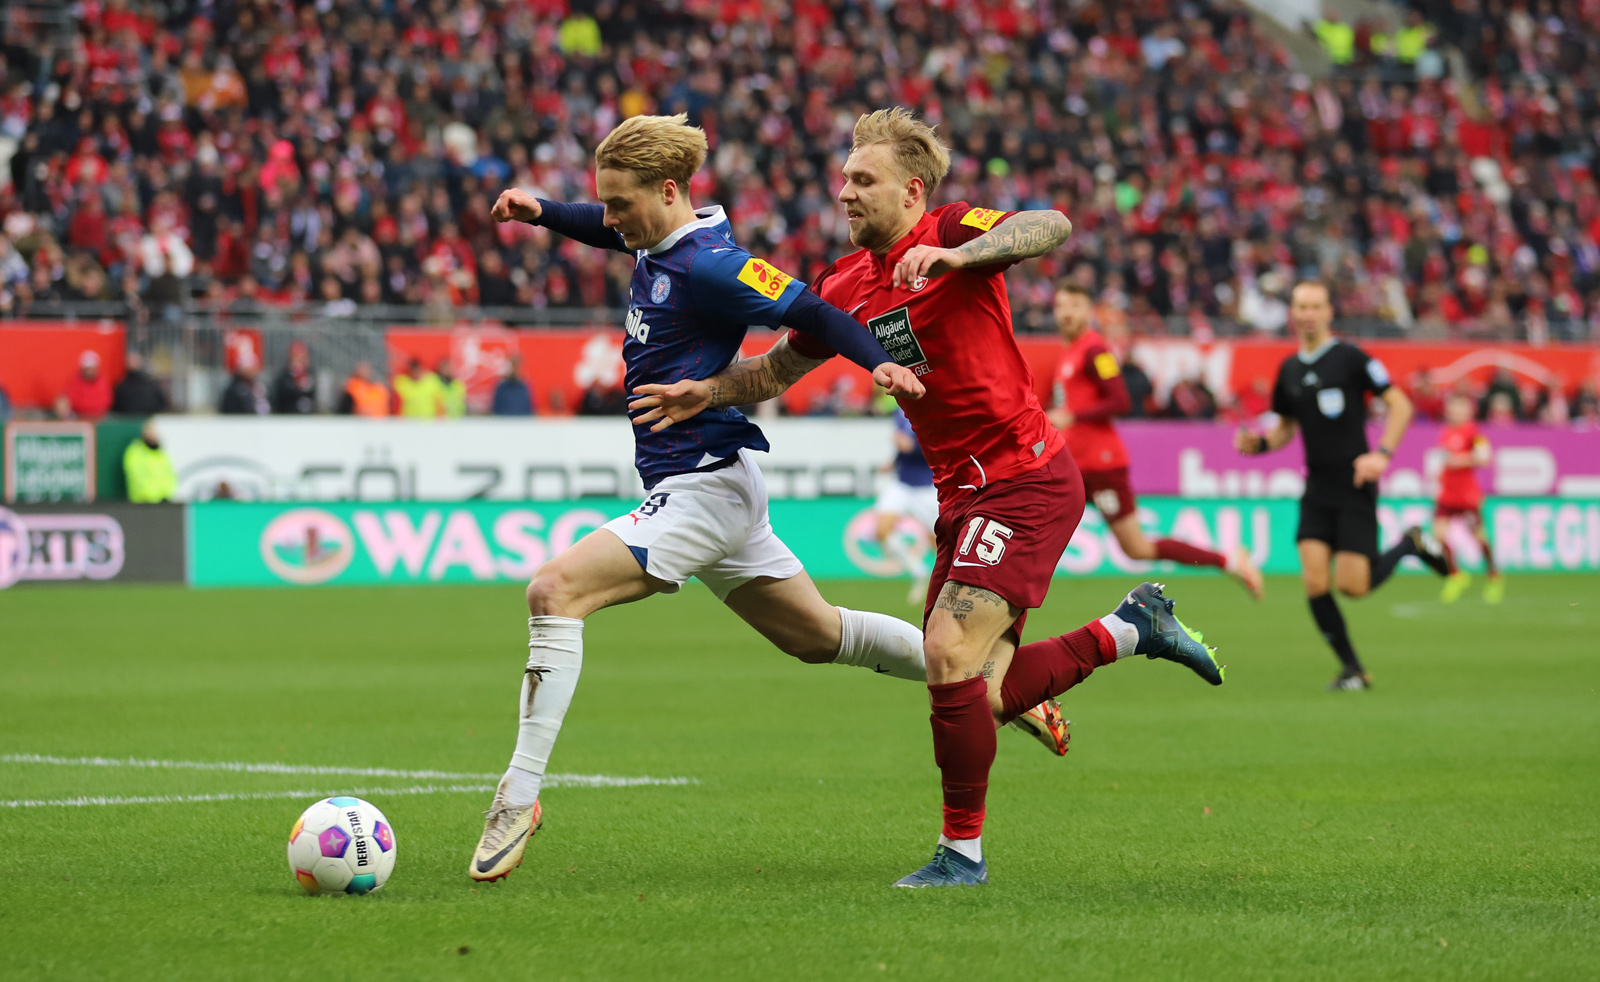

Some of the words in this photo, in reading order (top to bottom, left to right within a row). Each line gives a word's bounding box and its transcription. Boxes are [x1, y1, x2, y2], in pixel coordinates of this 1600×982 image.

[875, 319, 906, 339] Allgäuer
[881, 333, 912, 350] atschen
[914, 363, 934, 377] GEL
[958, 516, 1014, 566] 15
[346, 811, 368, 867] DERBYSTAR
